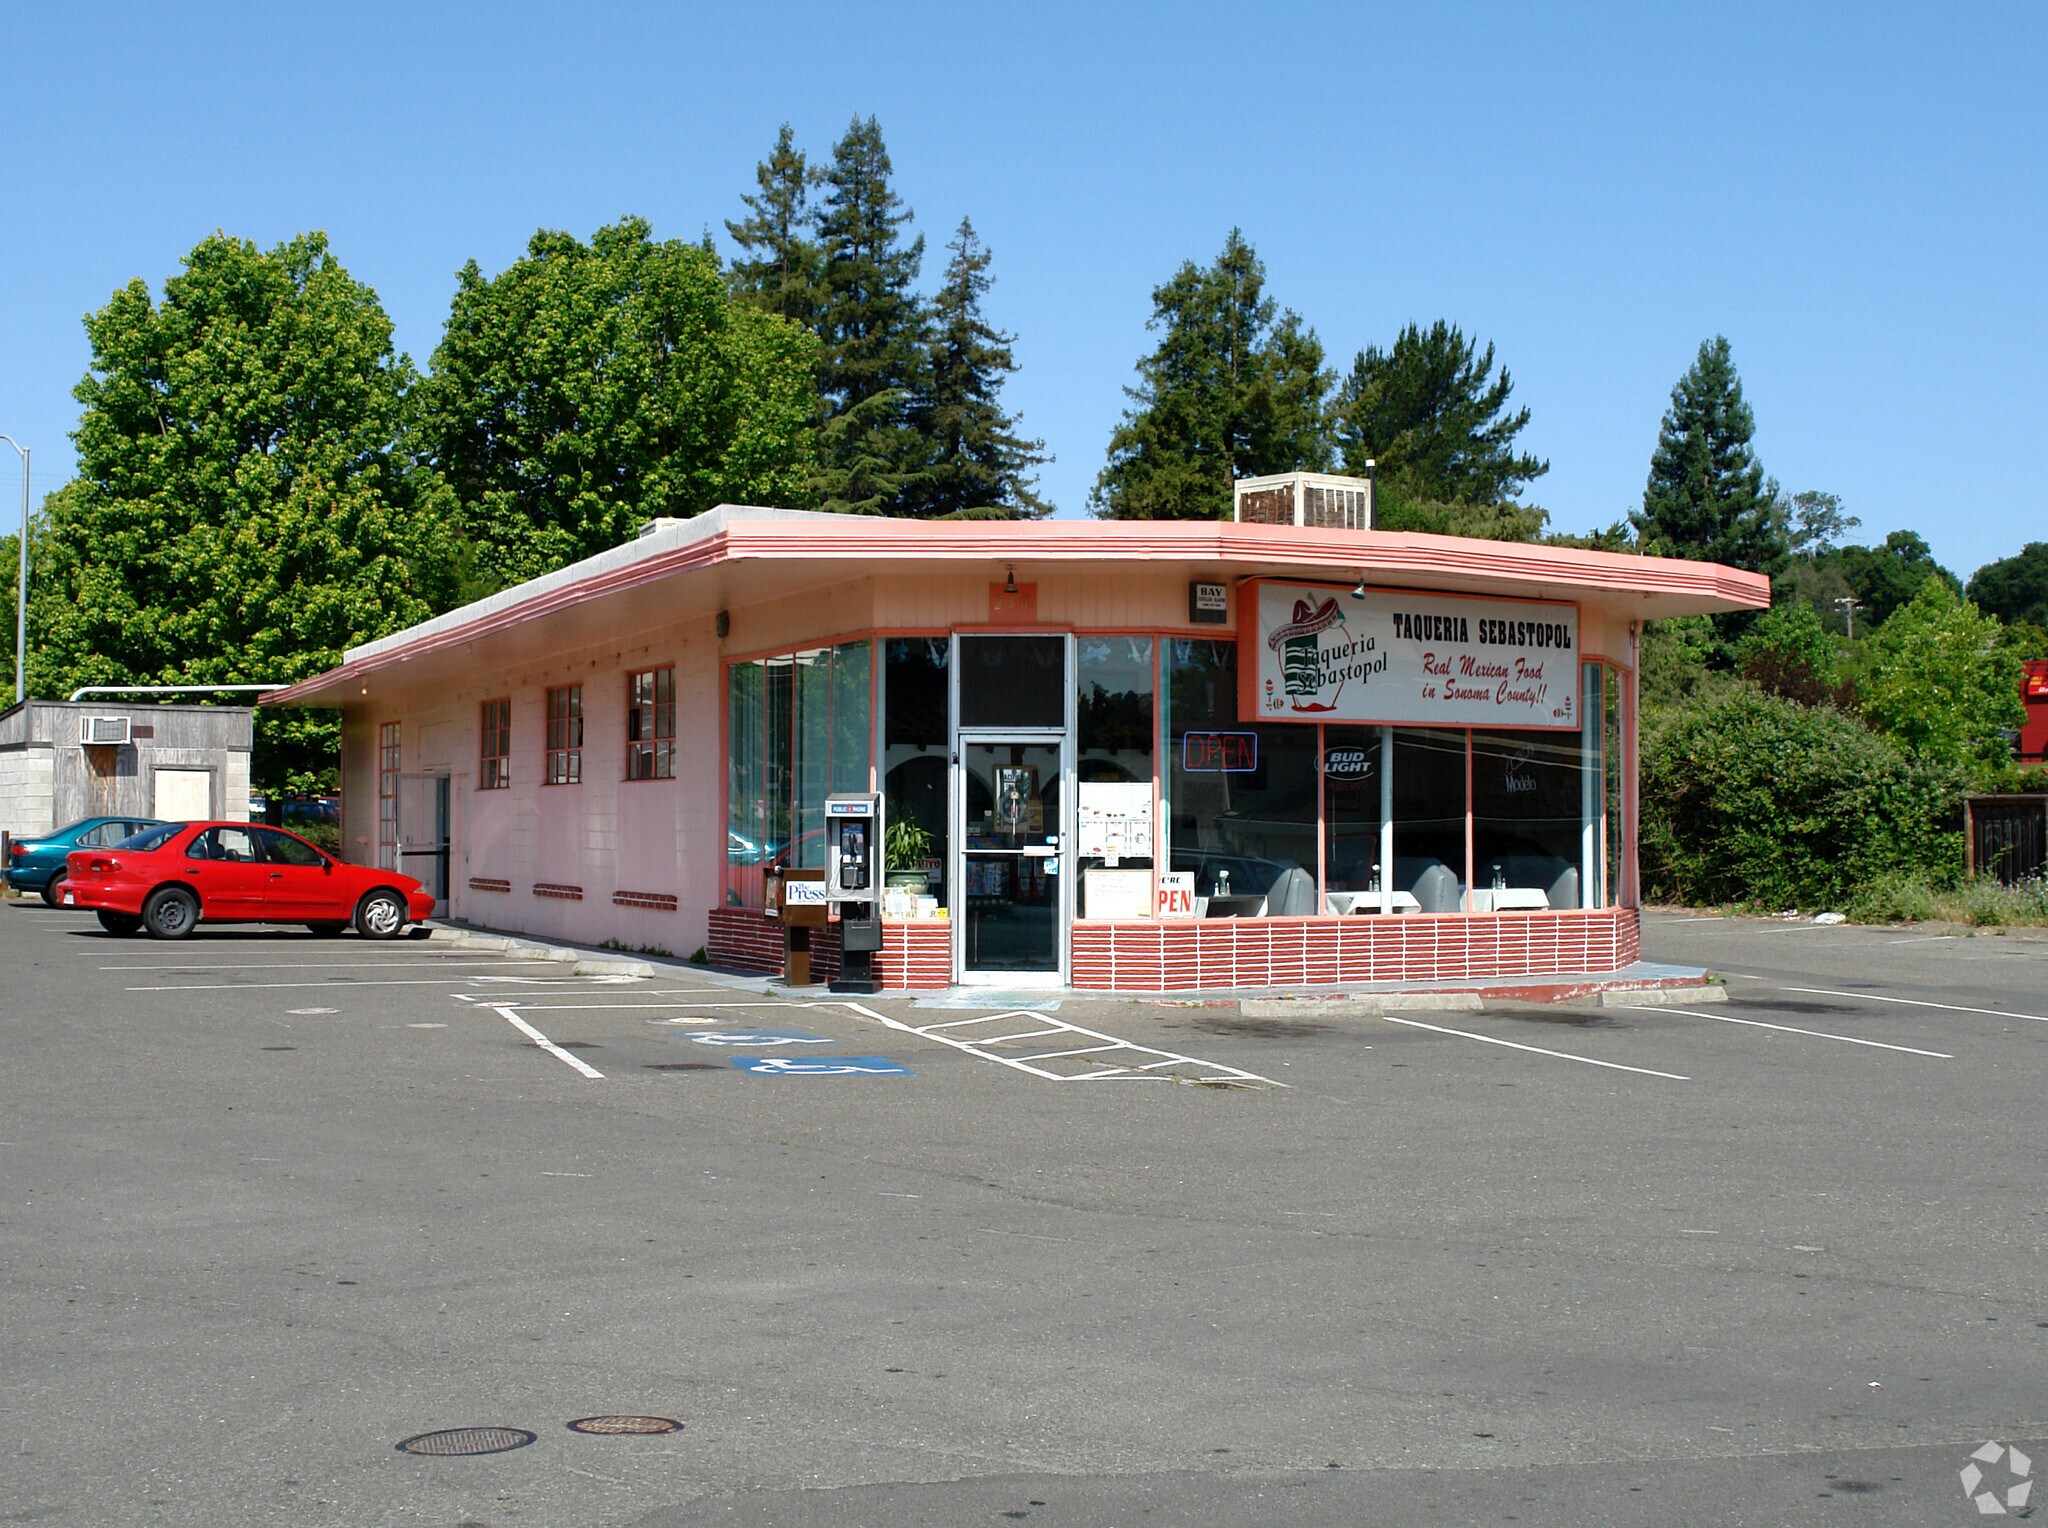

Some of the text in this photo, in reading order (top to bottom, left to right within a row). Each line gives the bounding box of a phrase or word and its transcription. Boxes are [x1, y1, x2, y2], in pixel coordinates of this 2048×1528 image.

[1201, 587, 1222, 596] BAY
[1393, 613, 1571, 649] TAQUERIA SEBASTOPOL
[1301, 634, 1375, 670] Taqueria
[1297, 651, 1387, 693] Sebastopol
[1423, 652, 1544, 682] Real Mexican Food
[1422, 678, 1548, 708] in Sonoma County!!
[1187, 735, 1255, 768] OPEN
[1330, 752, 1365, 762] BUD
[1323, 762, 1372, 772] LIGHT
[1505, 774, 1537, 792] Modelo
[1160, 876, 1181, 884] E'RE
[788, 884, 826, 900] Press
[1159, 890, 1191, 912] PEN
